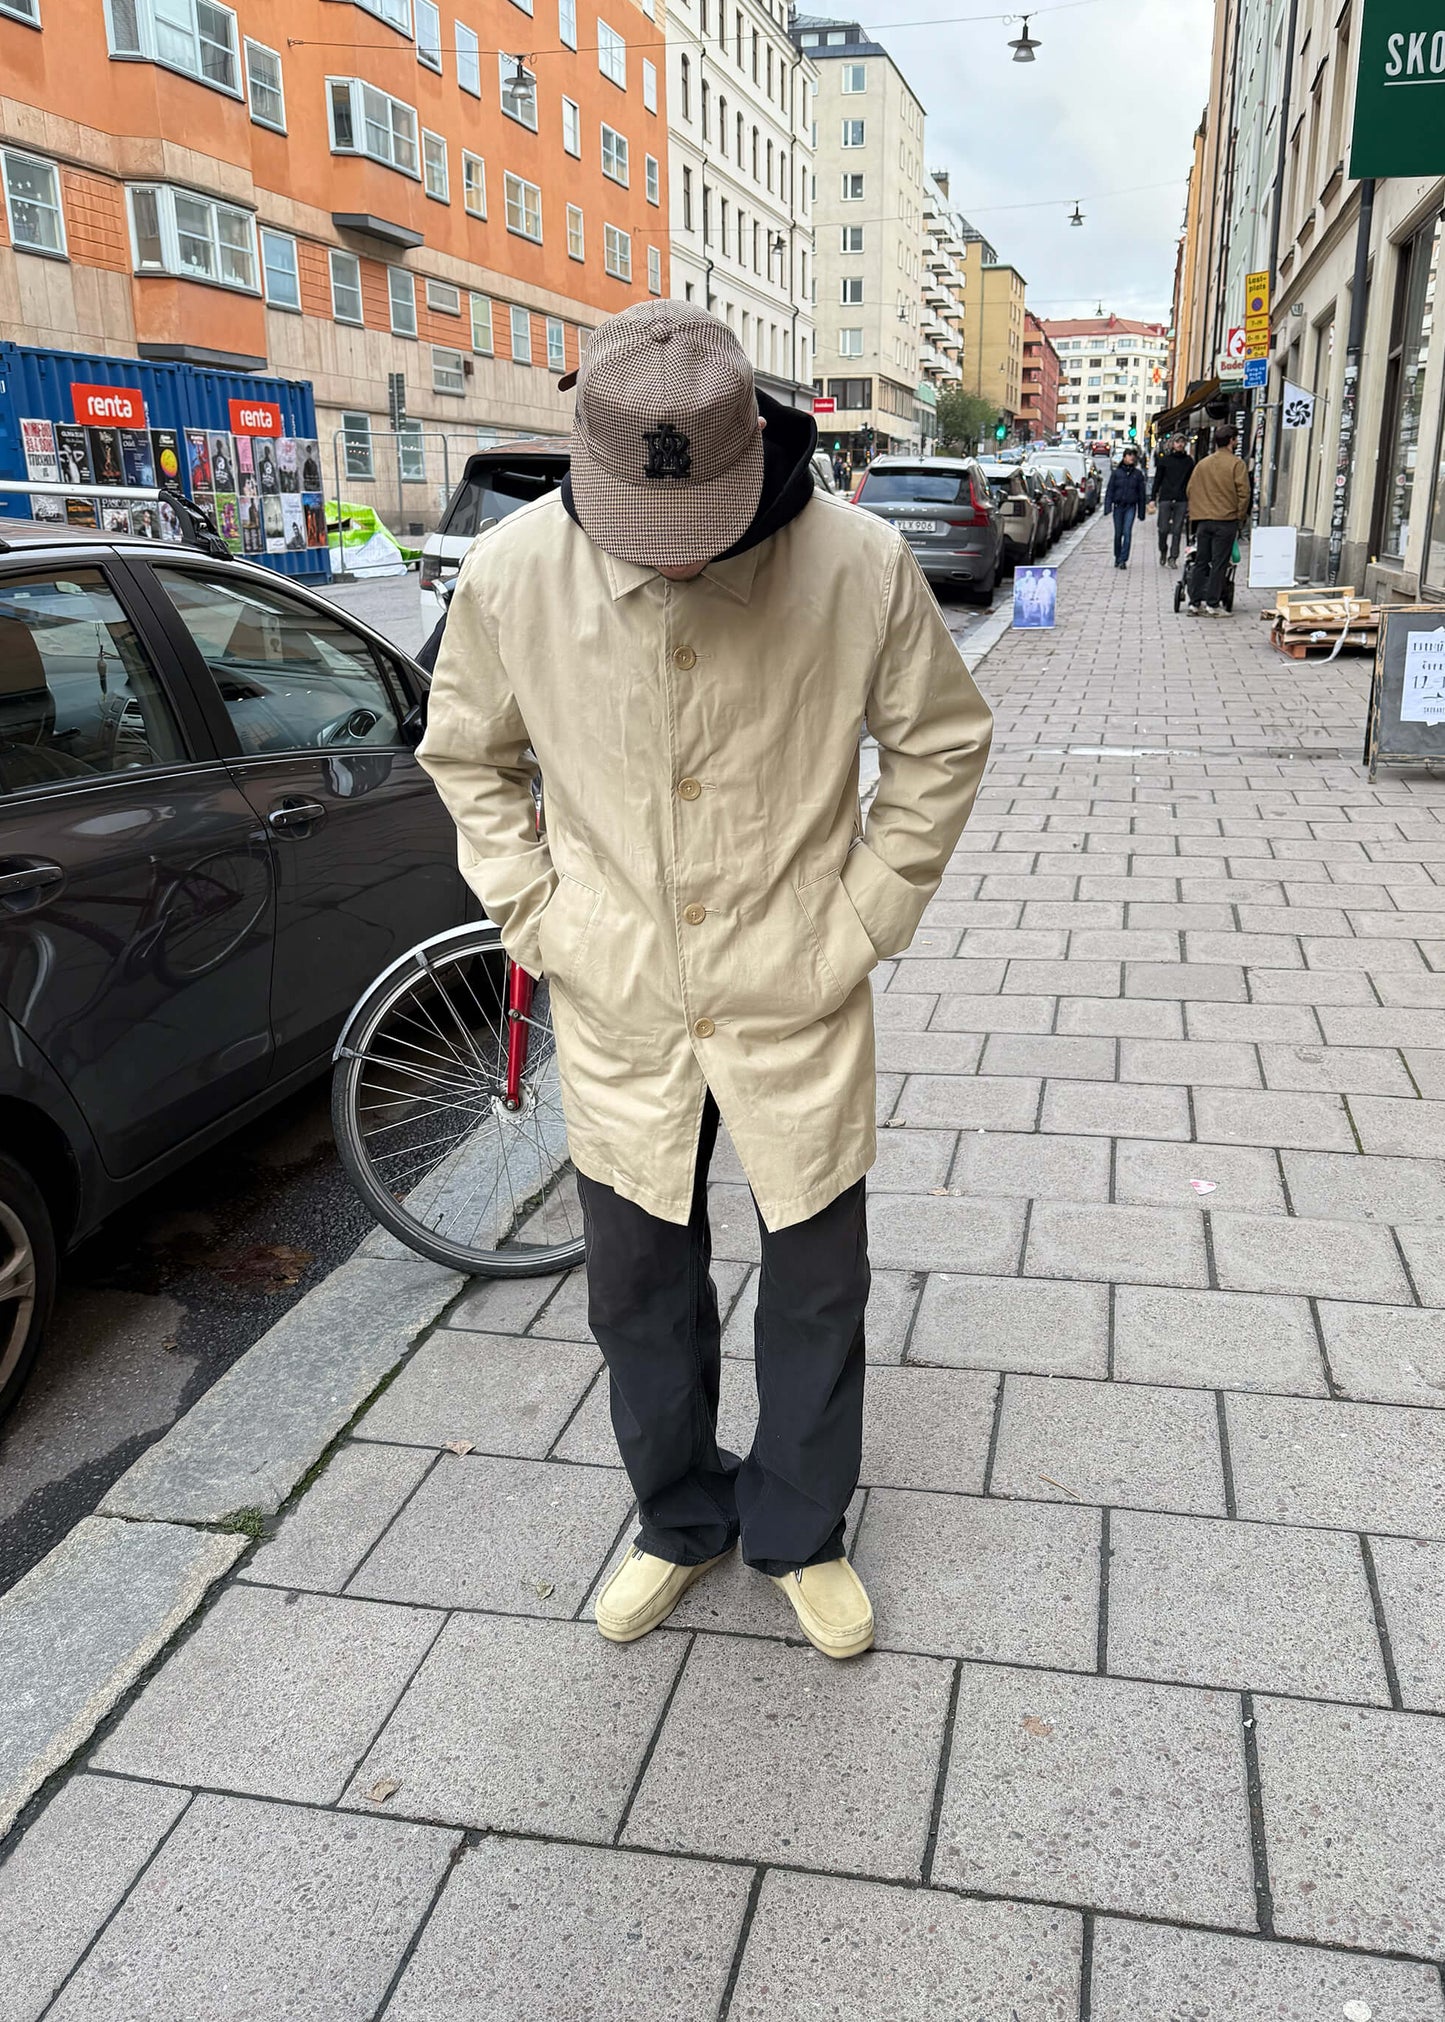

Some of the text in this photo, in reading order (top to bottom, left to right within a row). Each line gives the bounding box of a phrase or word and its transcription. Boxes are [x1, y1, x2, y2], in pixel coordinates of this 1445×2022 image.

[87, 394, 133, 419] renta
[239, 408, 273, 429] renta
[915, 521, 933, 531] 906
